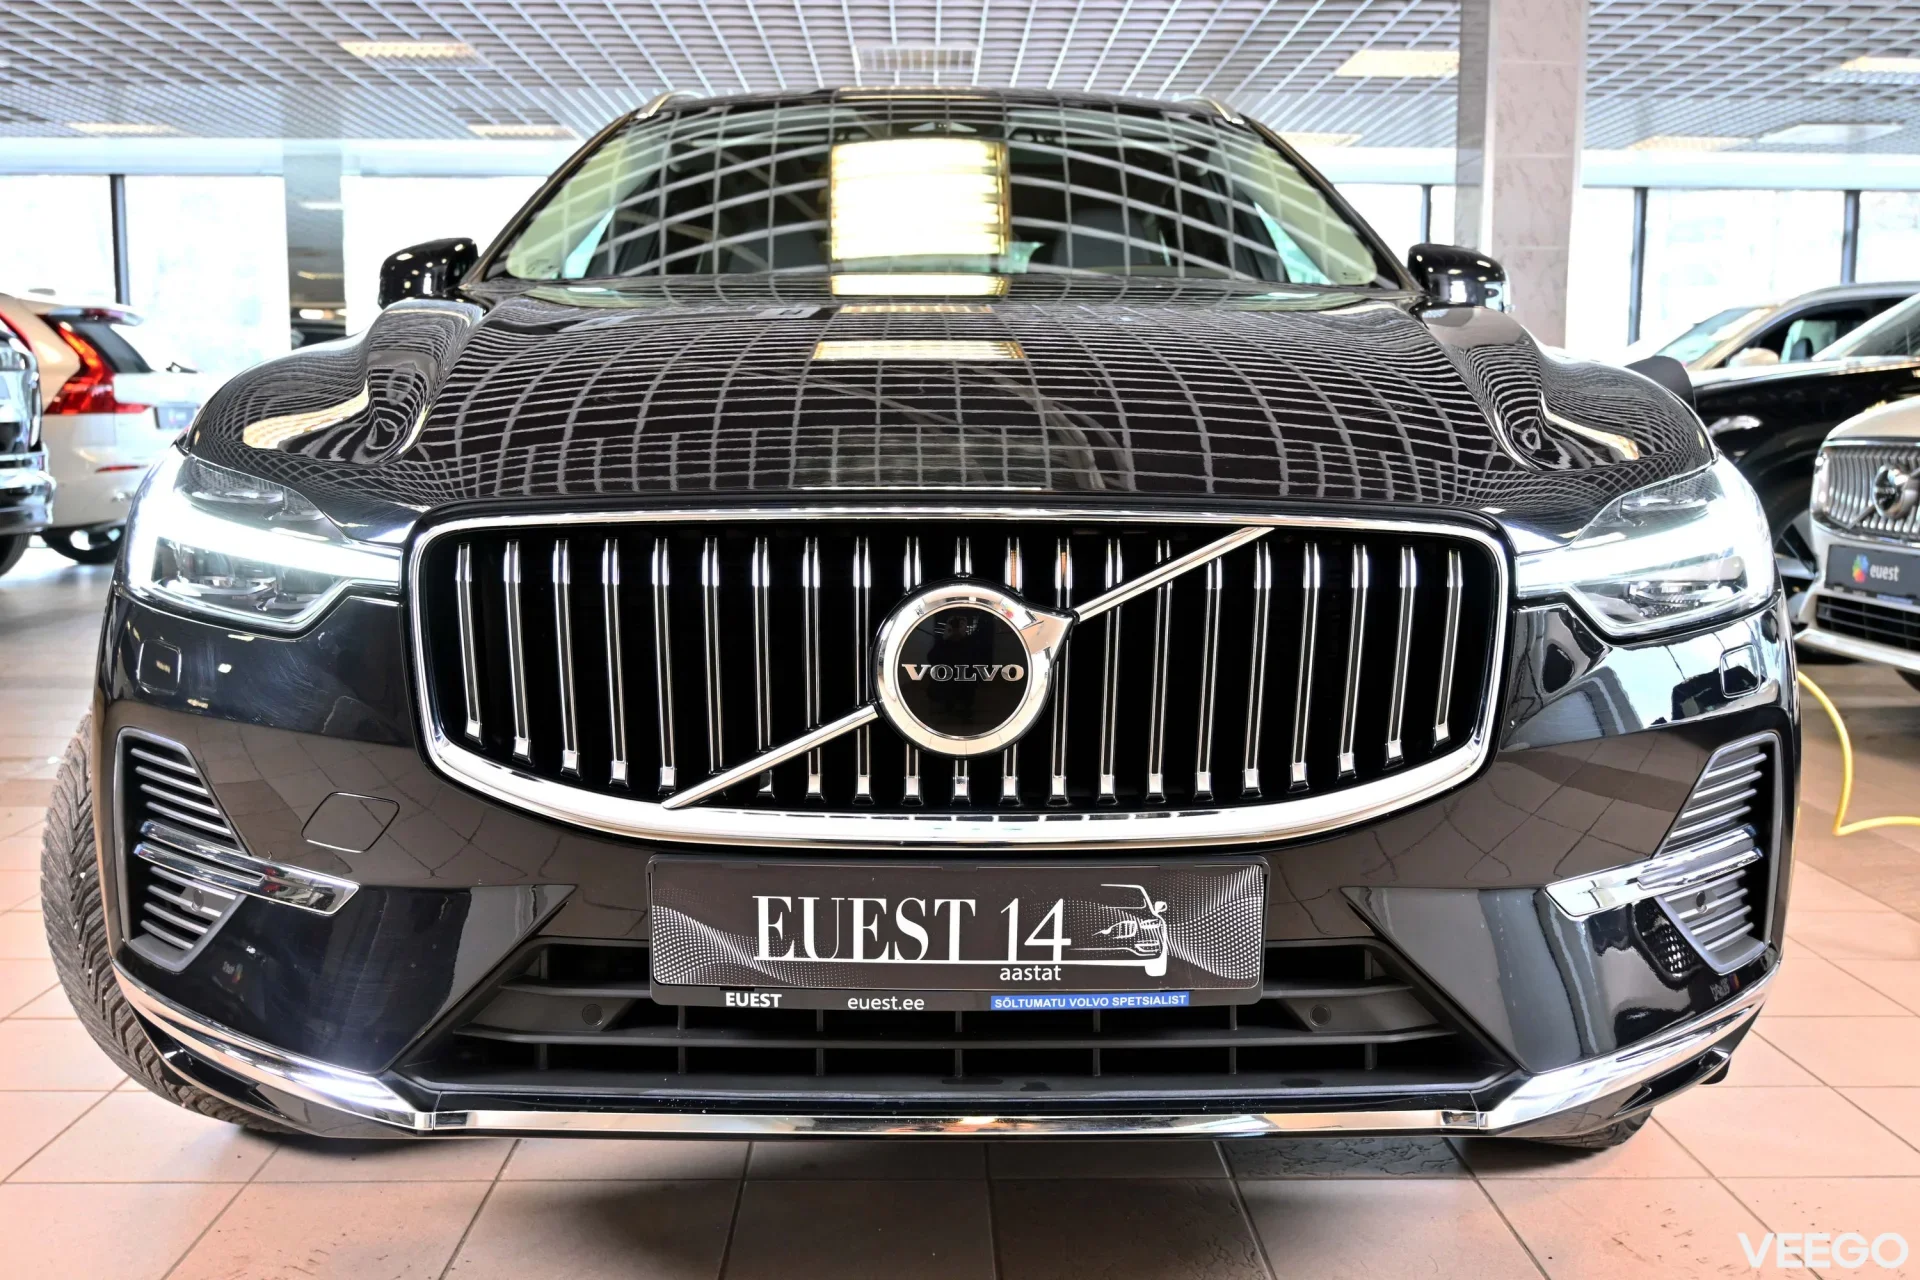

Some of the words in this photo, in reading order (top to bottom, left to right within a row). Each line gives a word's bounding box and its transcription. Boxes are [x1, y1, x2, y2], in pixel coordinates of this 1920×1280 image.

[1869, 564, 1900, 582] euest
[902, 664, 1025, 682] VOLVO
[752, 896, 976, 961] EUEST
[1000, 897, 1072, 962] 14
[999, 965, 1062, 981] aastat
[725, 992, 782, 1008] EUEST
[847, 996, 925, 1011] euest.ee
[994, 996, 1066, 1009] SÕLTUMATU
[1069, 996, 1109, 1008] VOLVO
[1112, 994, 1187, 1007] SPETSIALIST
